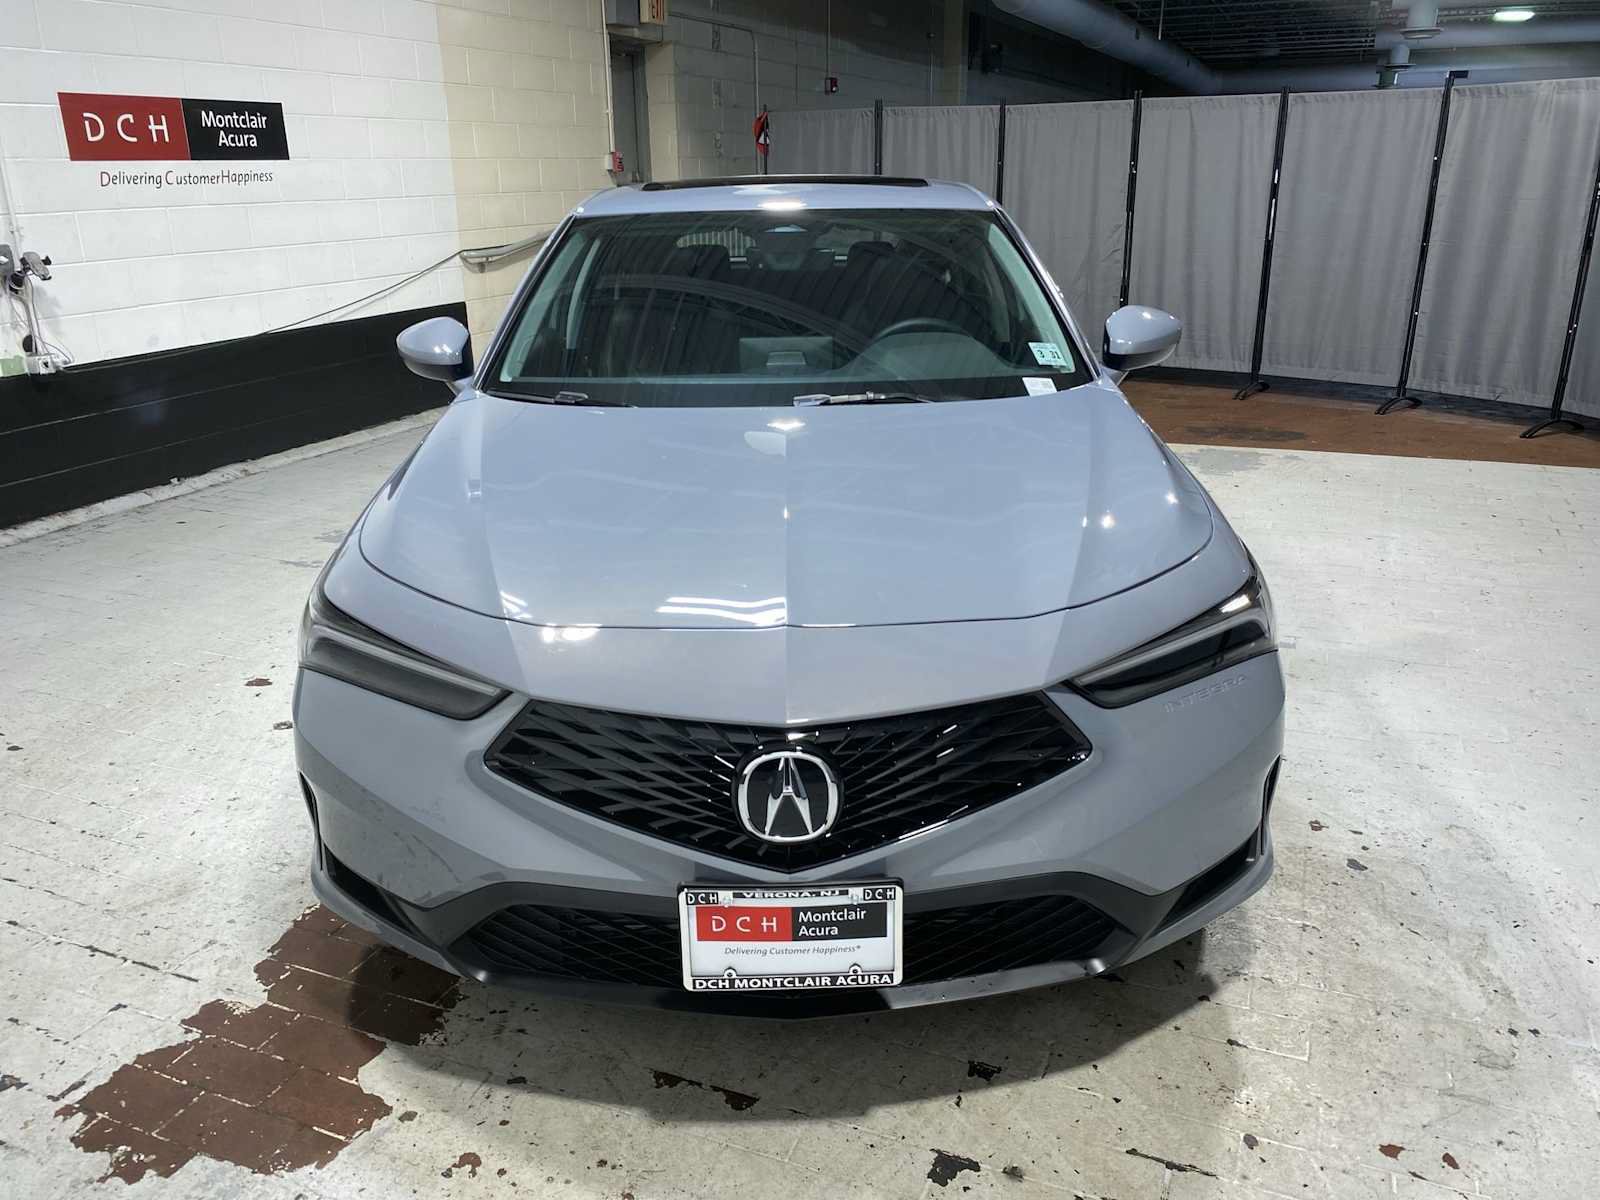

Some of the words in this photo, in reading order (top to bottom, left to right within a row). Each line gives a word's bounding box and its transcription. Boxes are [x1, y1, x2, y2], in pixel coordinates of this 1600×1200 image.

[201, 110, 268, 129] Montclair
[218, 130, 258, 147] Acura
[100, 171, 162, 189] Delivering
[820, 889, 840, 897] NJ
[798, 908, 867, 923] Montclair
[798, 926, 839, 937] Acura
[724, 946, 768, 957] Delivering
[769, 946, 811, 954] Customer
[695, 979, 730, 989] DCH
[734, 977, 833, 988] MONTCLAIR
[836, 974, 892, 986] ACURA
